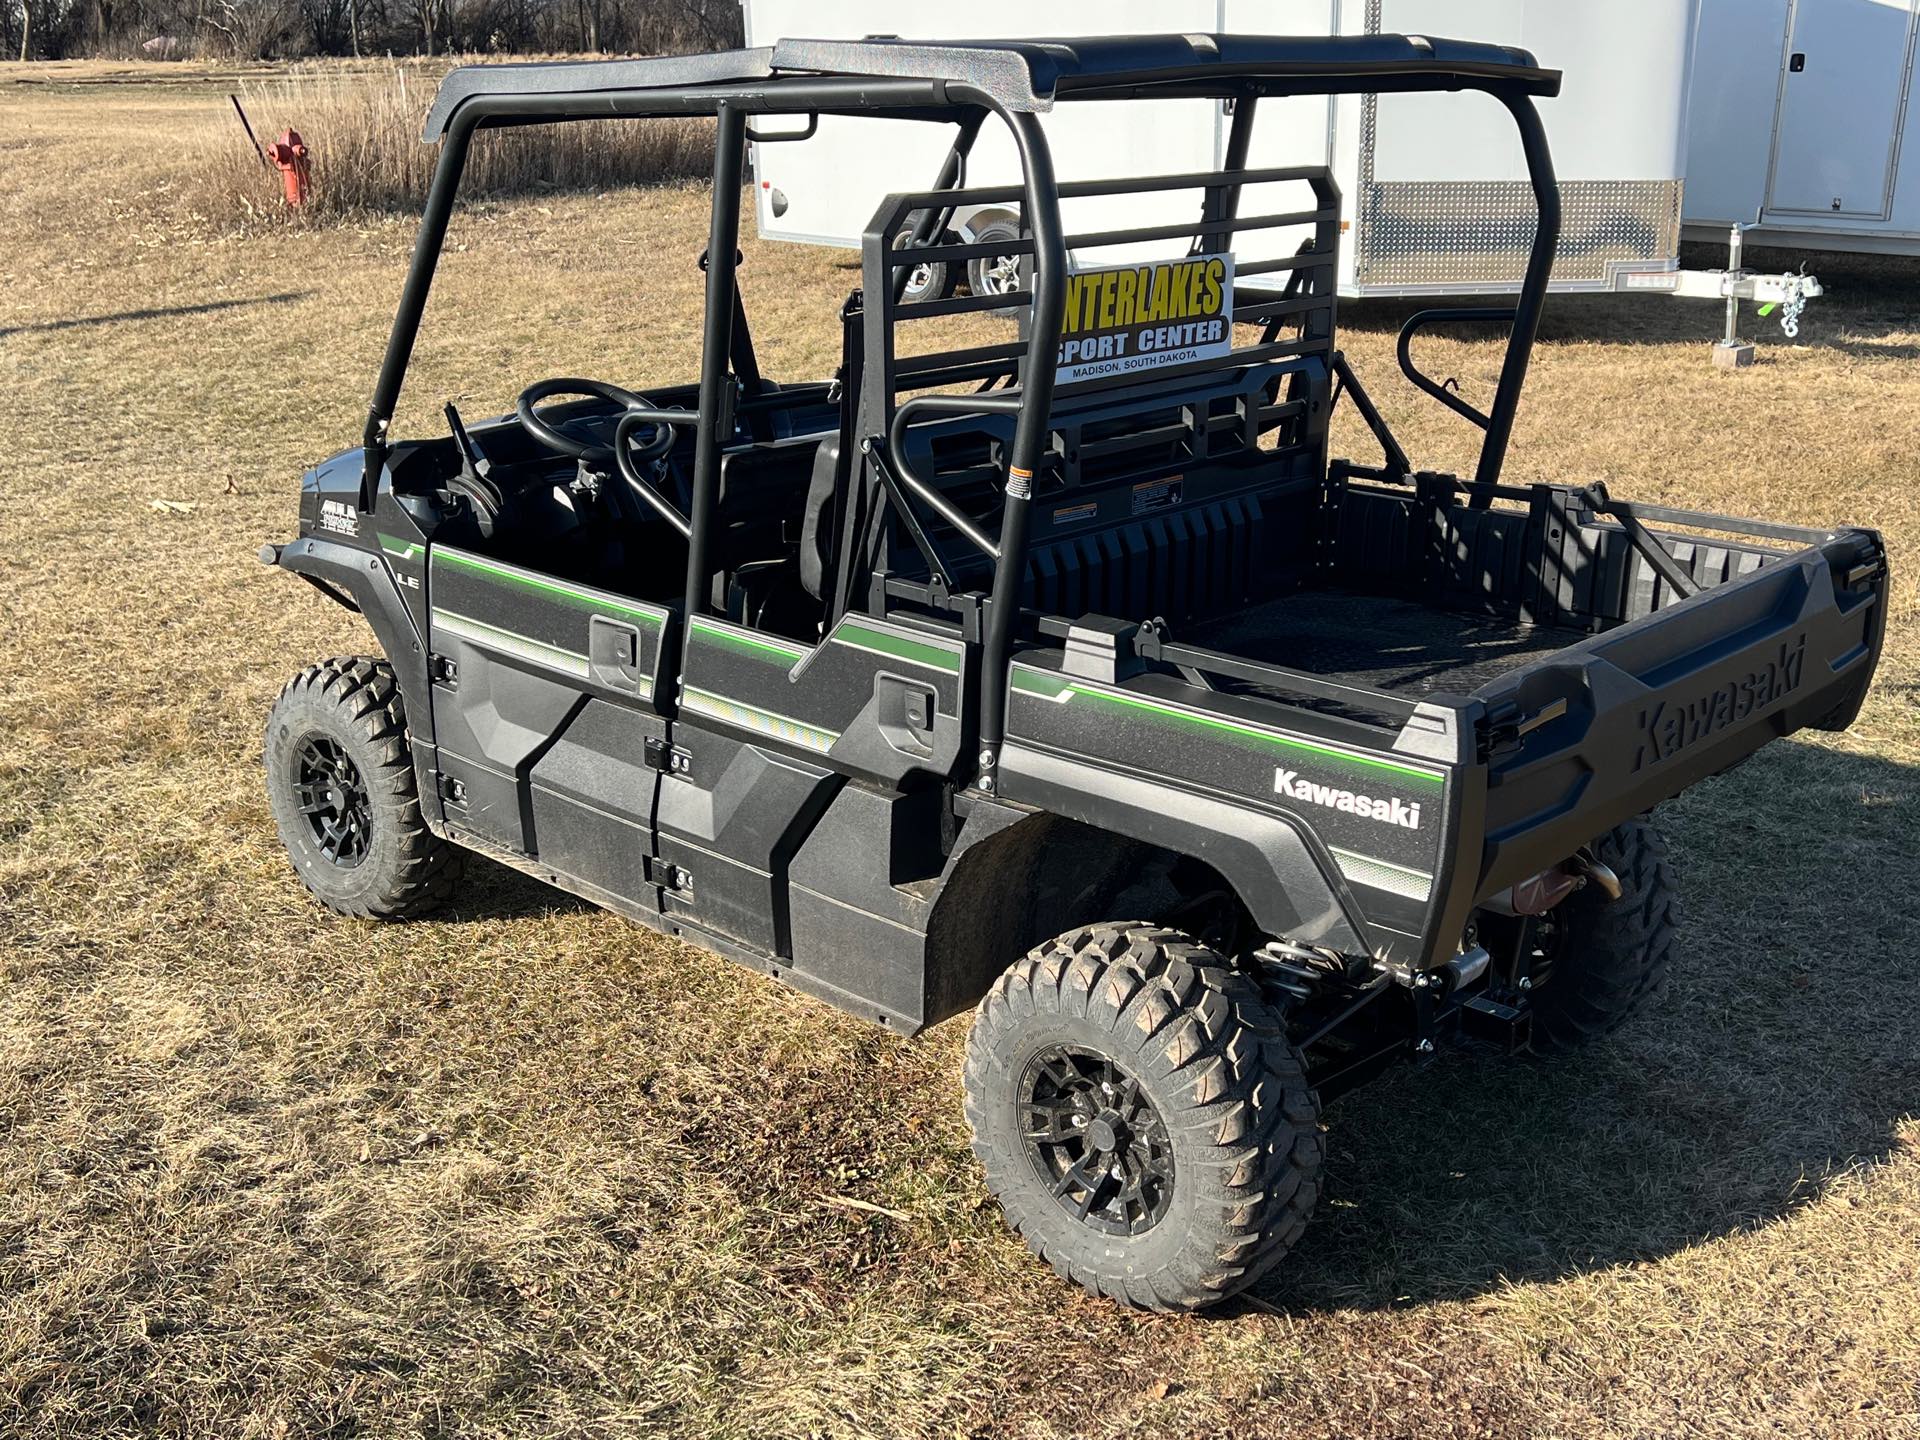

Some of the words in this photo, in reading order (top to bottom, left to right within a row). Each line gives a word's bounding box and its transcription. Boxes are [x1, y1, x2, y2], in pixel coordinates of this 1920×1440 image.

[1061, 259, 1224, 334] NTERLAKES
[1138, 320, 1223, 351] CENTER
[1072, 360, 1122, 379] MADISON,
[1124, 355, 1157, 370] SOUTH
[1158, 350, 1197, 364] DAKOTA
[397, 572, 420, 590] LE
[1630, 632, 1807, 775] Kawasaki
[1273, 767, 1421, 830] Kawasaki
